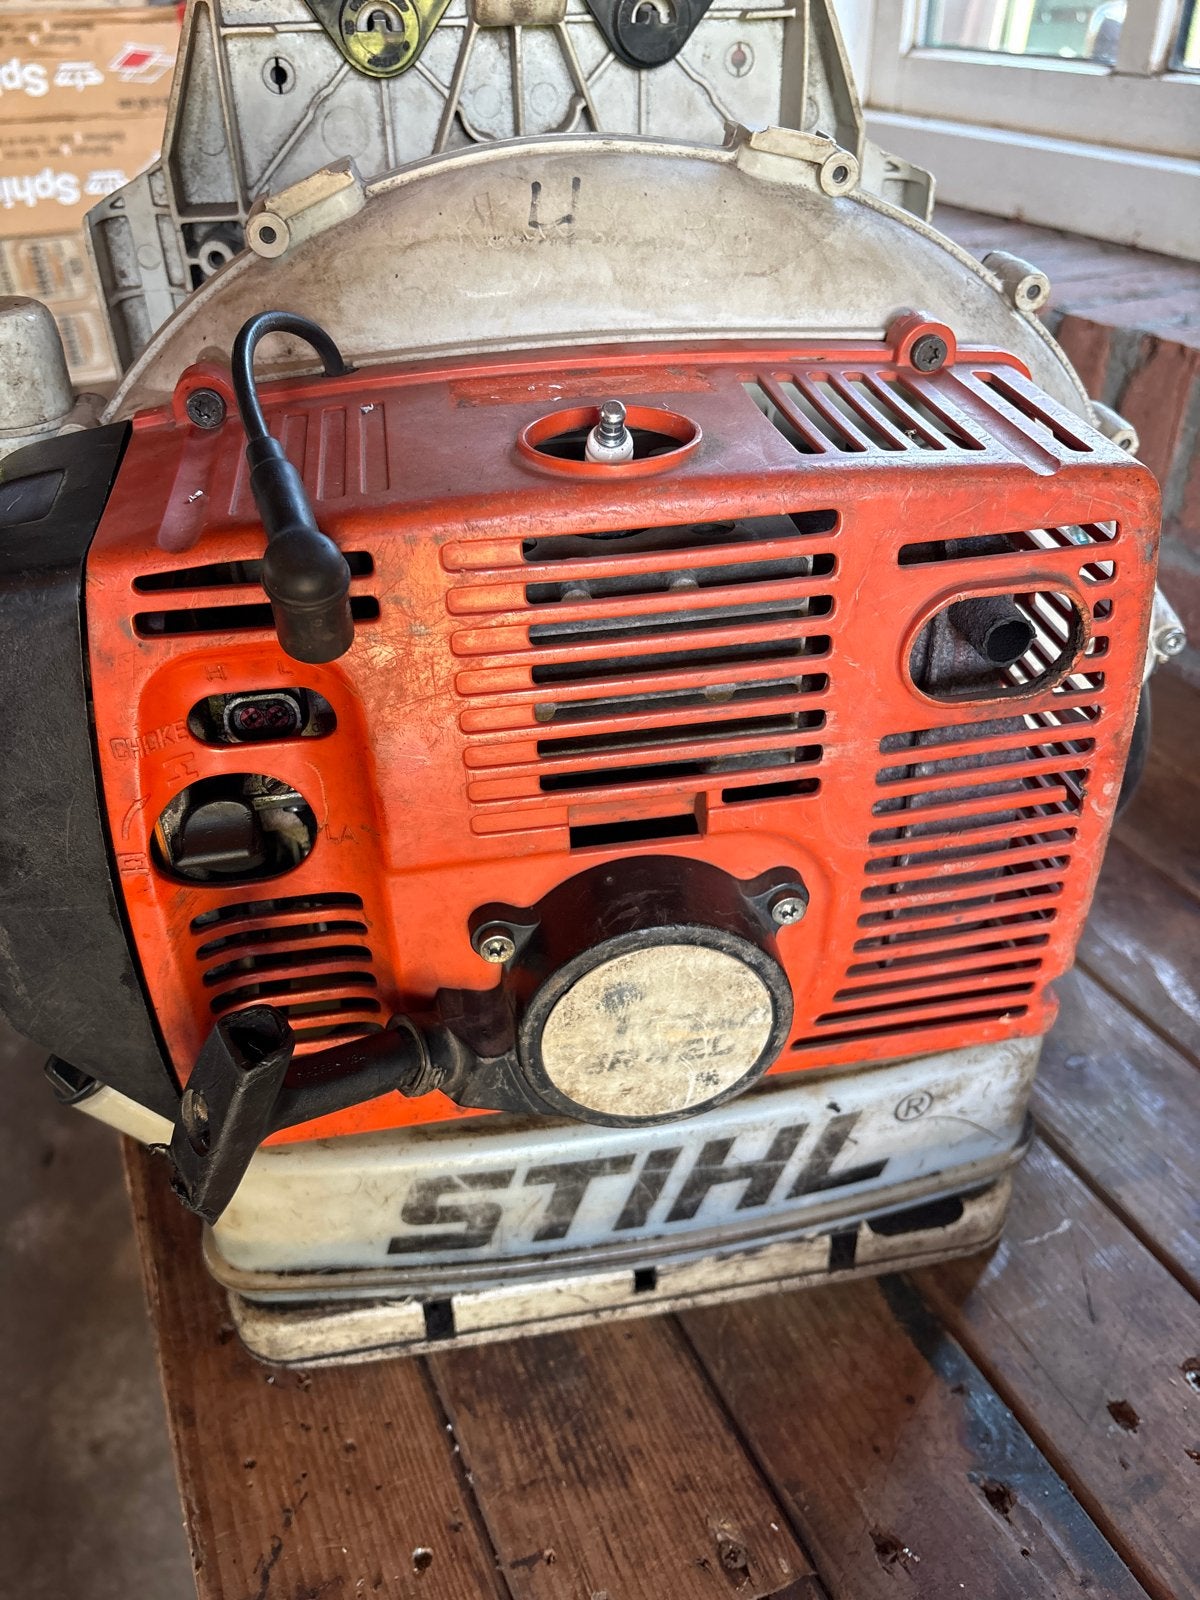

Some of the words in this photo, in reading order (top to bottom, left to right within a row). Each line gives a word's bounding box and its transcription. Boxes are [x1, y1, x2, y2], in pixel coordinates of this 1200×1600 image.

[0, 57, 49, 97] Sp
[0, 166, 81, 208] Sphi
[109, 719, 190, 761] CHOKE
[387, 1110, 891, 1255] STIHL
